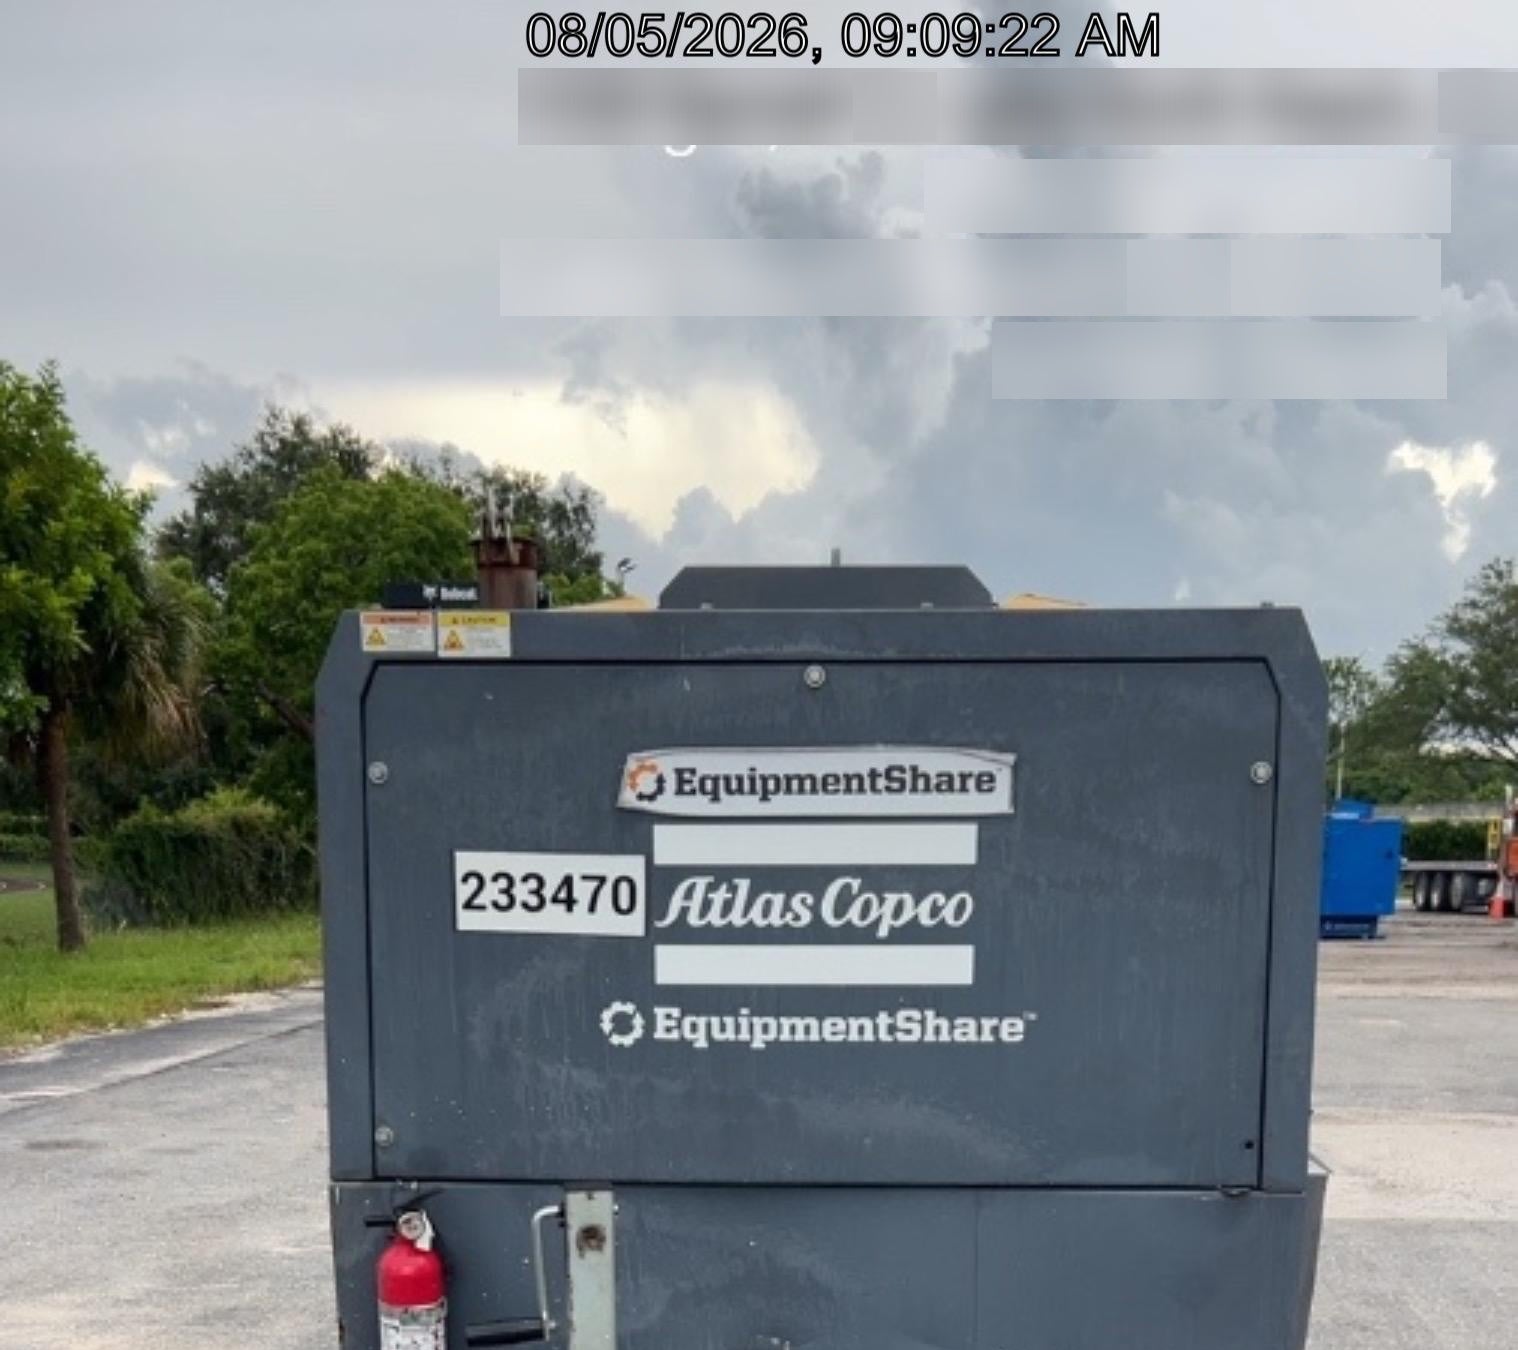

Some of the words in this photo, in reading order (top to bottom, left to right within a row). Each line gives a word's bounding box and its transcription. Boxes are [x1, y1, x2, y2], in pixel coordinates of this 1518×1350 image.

[673, 765, 998, 802] EquipmentShare
[460, 871, 638, 915] 233470
[654, 876, 814, 928] Atlas
[820, 876, 974, 938] Copco
[653, 1006, 1026, 1049] EquipmentShare
